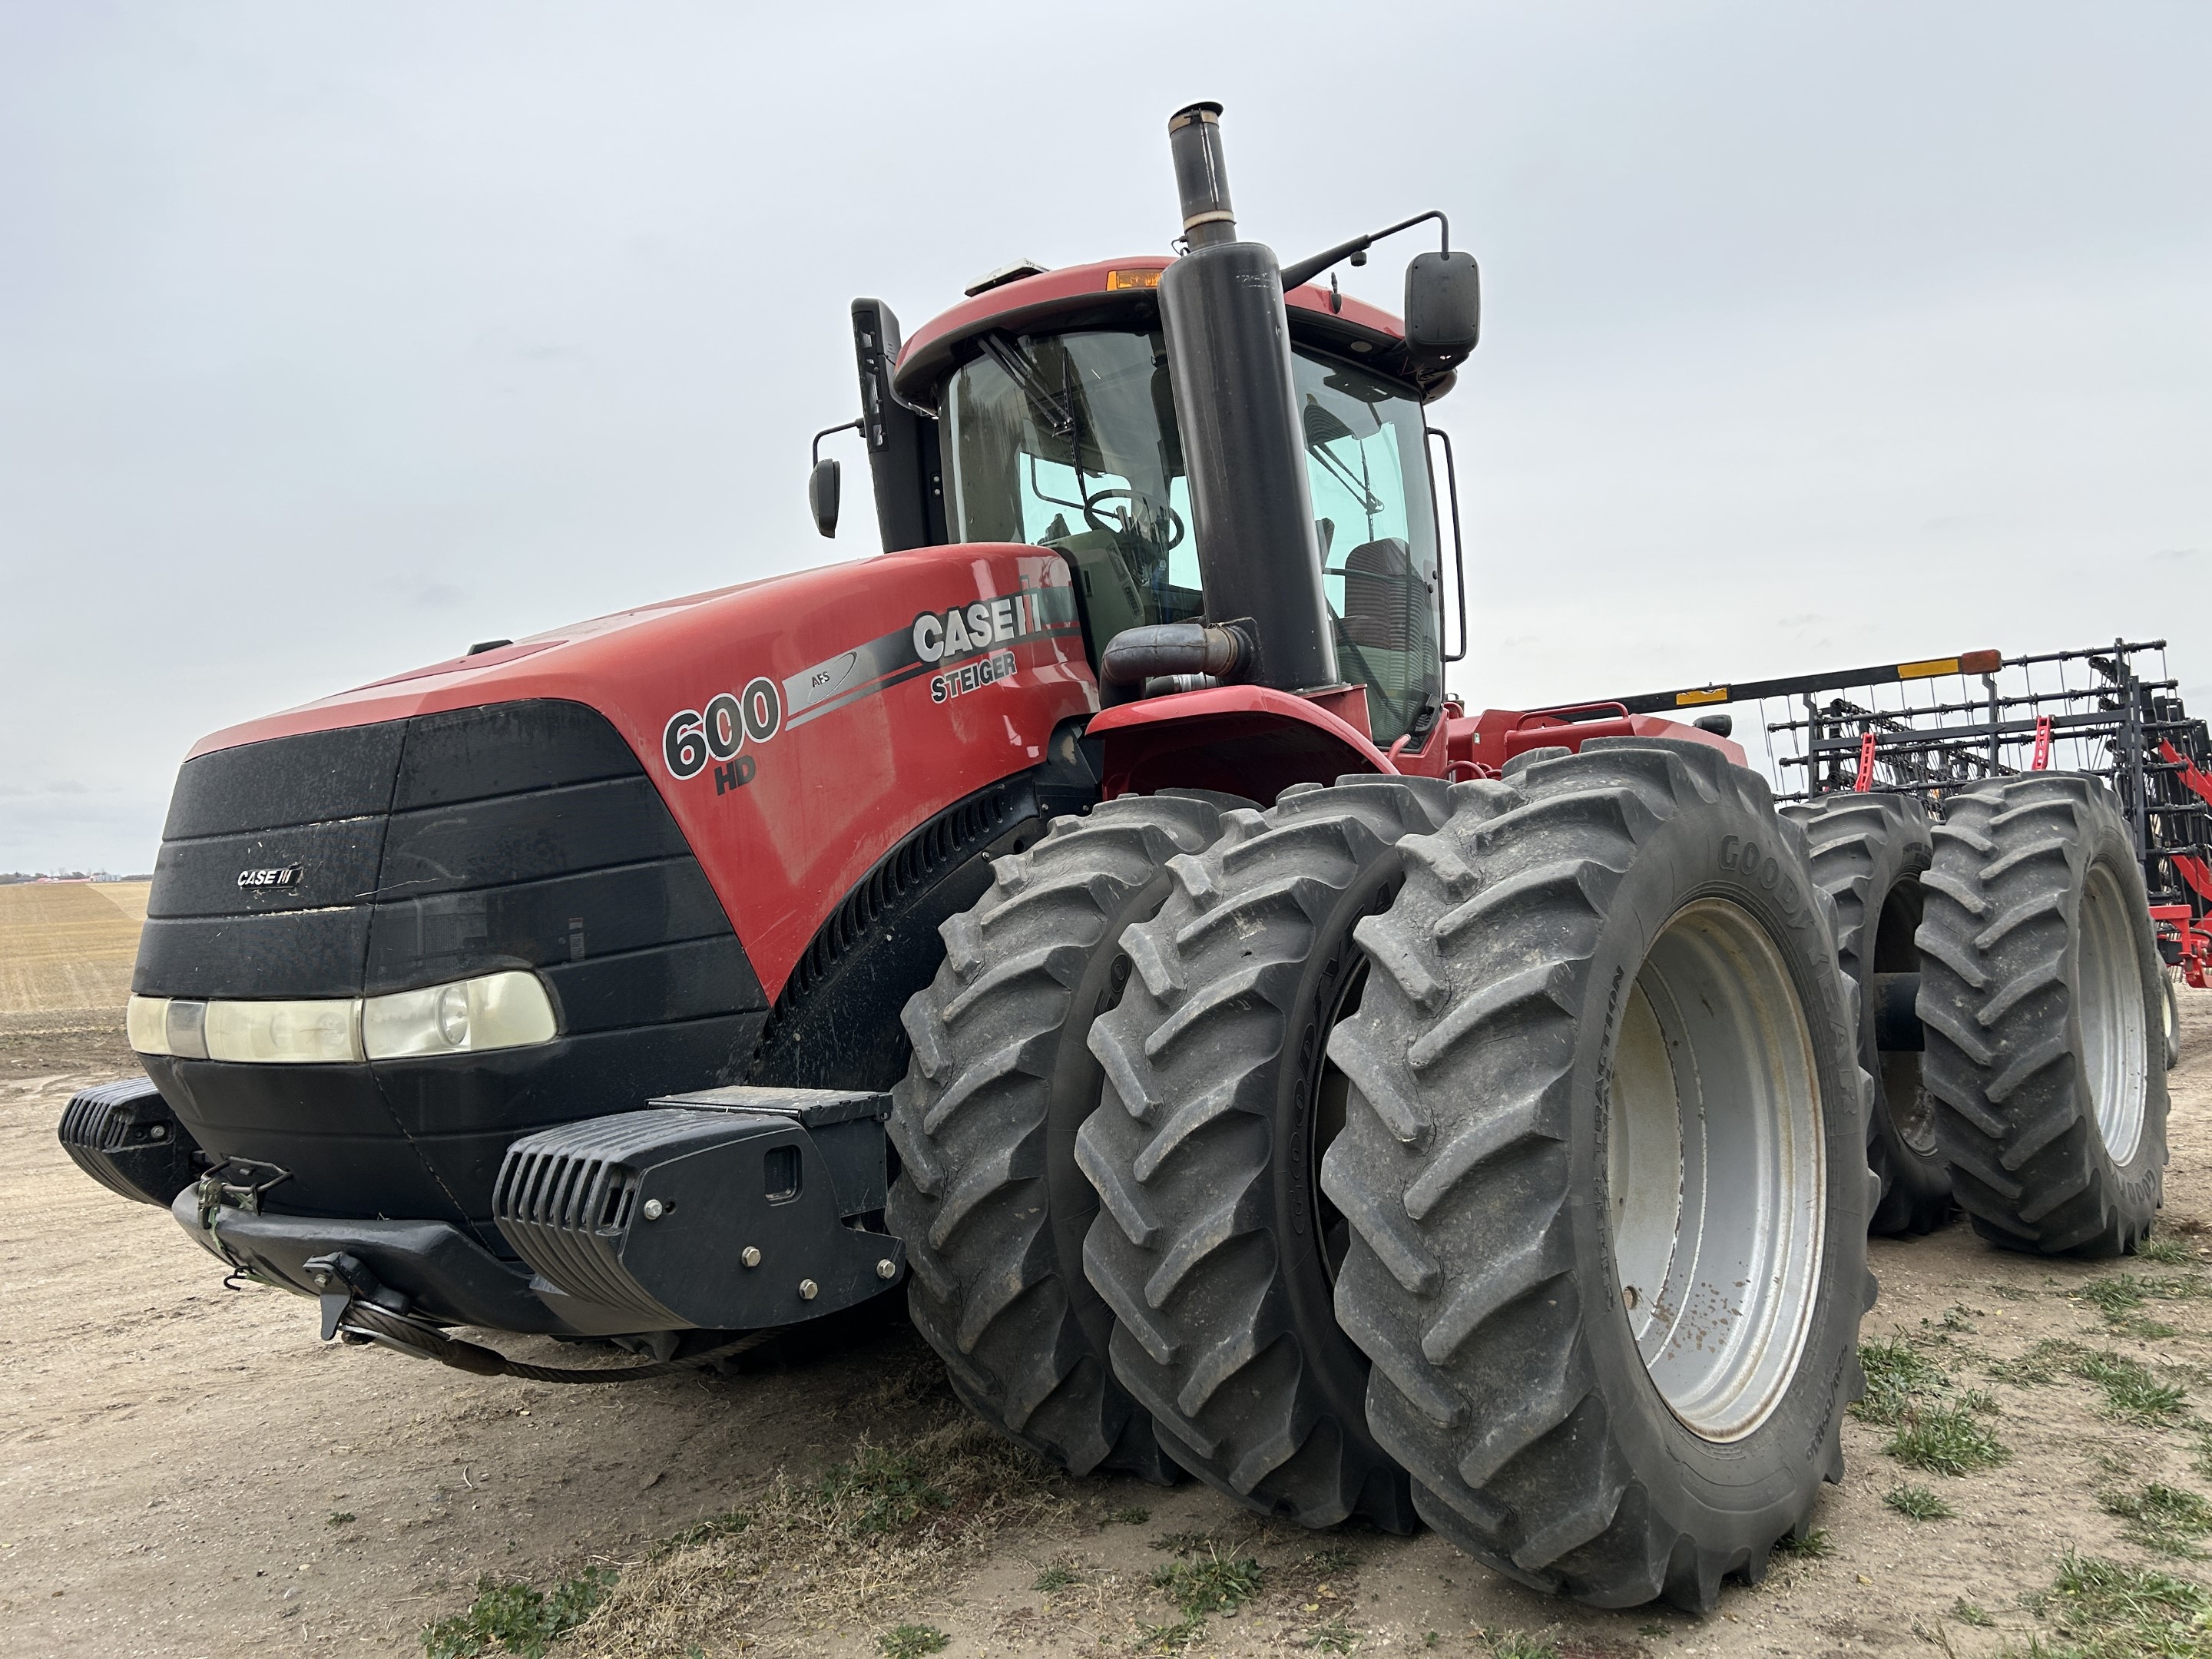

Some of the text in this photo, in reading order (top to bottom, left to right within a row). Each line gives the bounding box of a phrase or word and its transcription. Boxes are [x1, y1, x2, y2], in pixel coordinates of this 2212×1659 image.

[812, 671, 830, 688] AFS
[930, 651, 1018, 704] STEIGER
[663, 676, 781, 780] 600
[714, 755, 756, 796] HD
[237, 870, 276, 886] CASE
